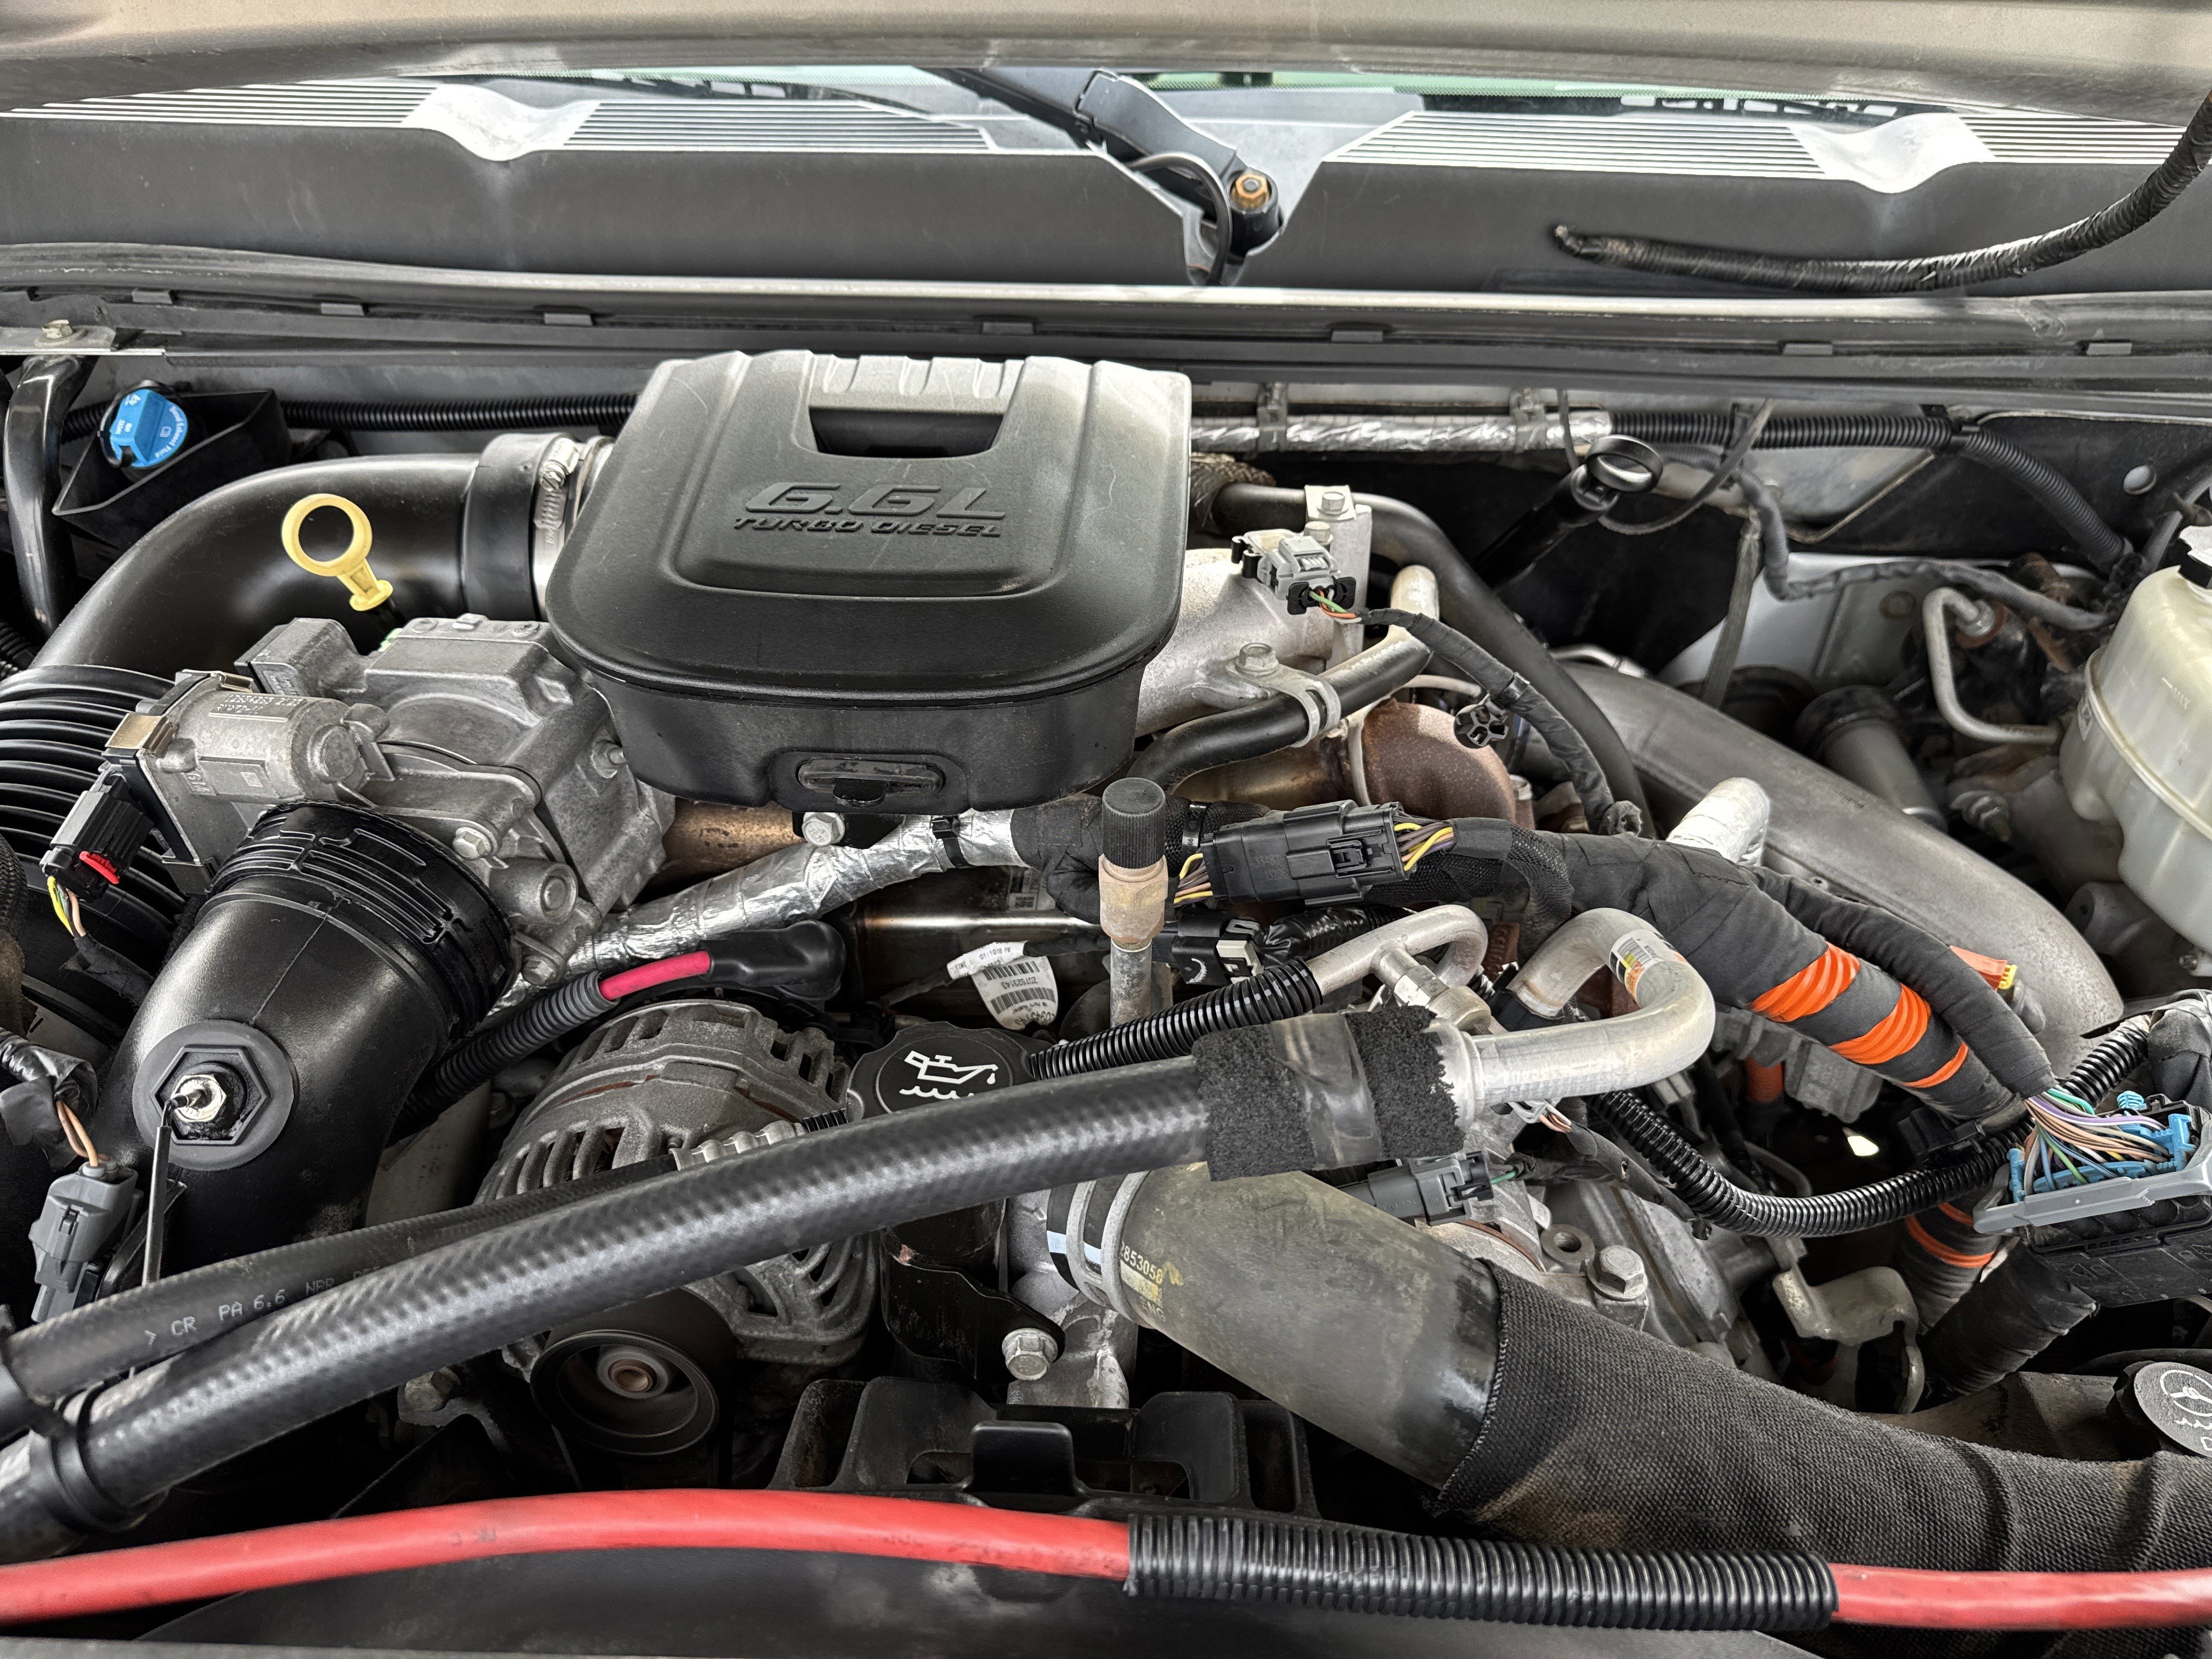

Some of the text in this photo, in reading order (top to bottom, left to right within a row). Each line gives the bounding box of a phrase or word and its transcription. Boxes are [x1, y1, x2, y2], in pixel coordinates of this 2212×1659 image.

[745, 482, 1006, 520] 6.6L
[733, 517, 1001, 538] TURBO DIESEL
[171, 1316, 197, 1336] CR
[219, 1301, 243, 1321] PA
